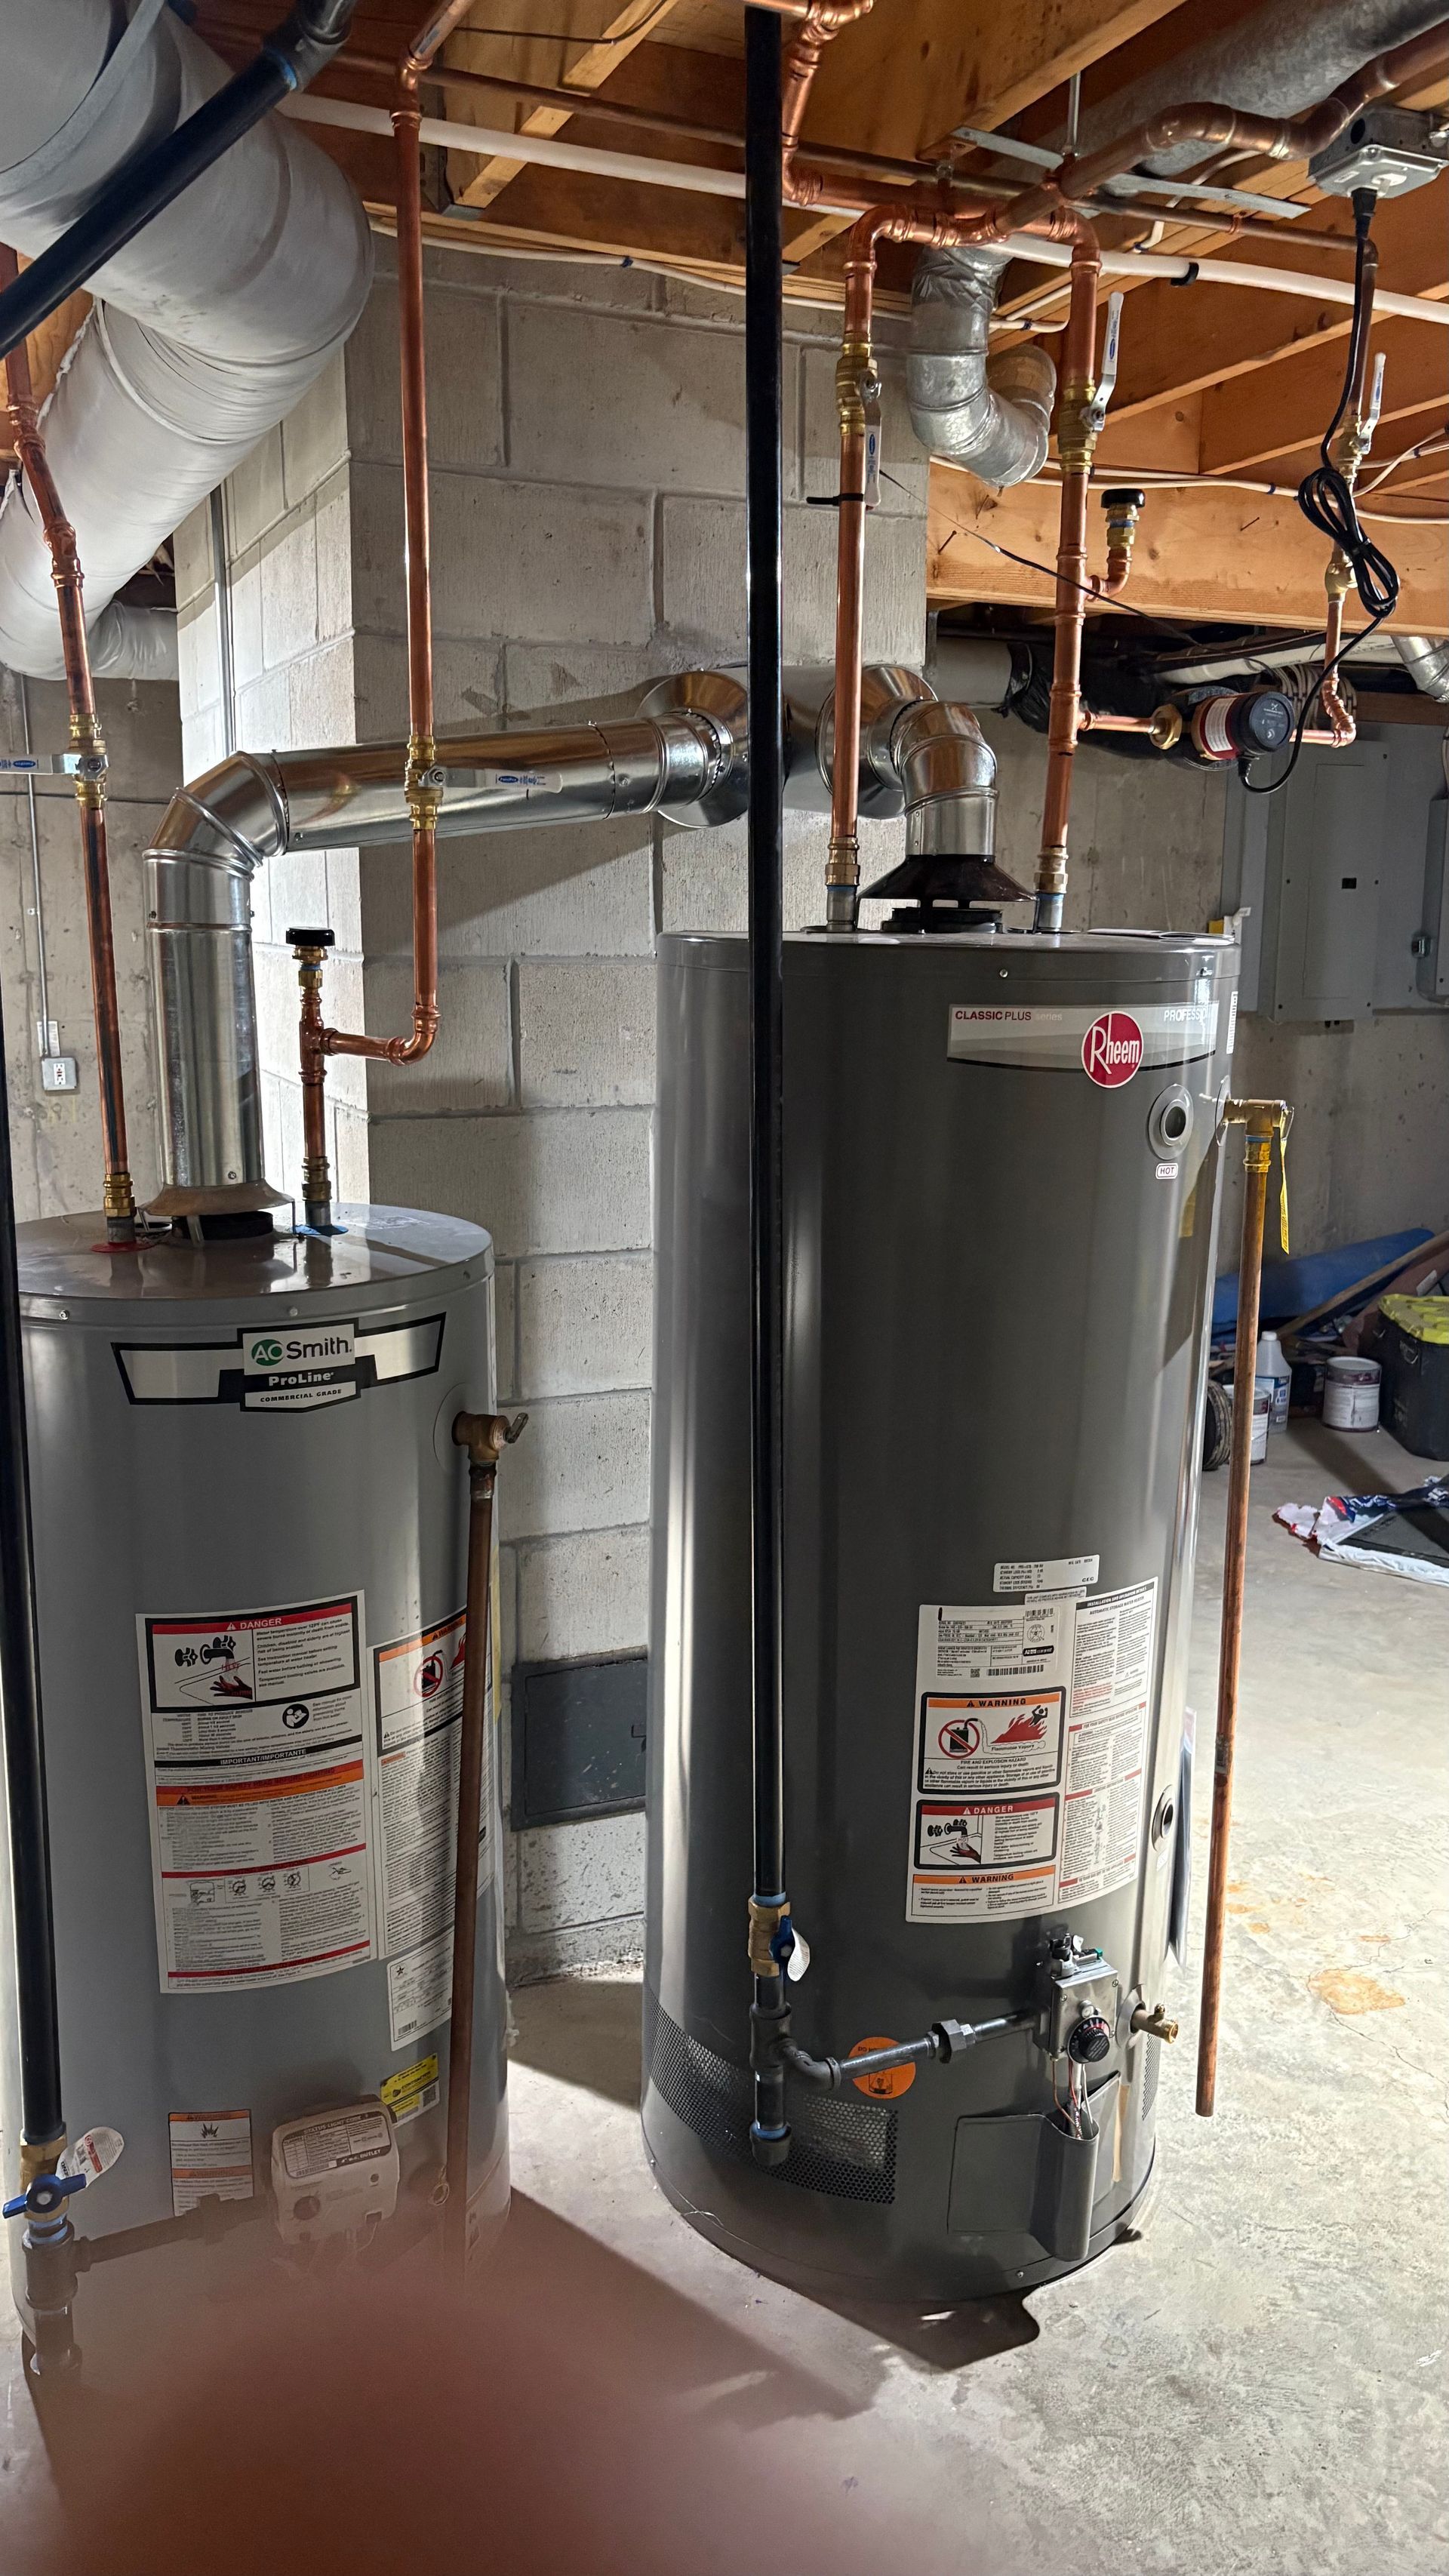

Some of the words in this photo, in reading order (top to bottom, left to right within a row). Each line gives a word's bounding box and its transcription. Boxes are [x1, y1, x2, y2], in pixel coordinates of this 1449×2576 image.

[955, 1011, 1002, 1020] CLASSIC
[1004, 1011, 1031, 1020] PLUS
[1090, 1014, 1140, 1075] Rheem
[260, 1393, 313, 1402] COMMERCIAL
[316, 1389, 342, 1397] GRADE
[240, 1618, 281, 1630] DANGER
[979, 1698, 1026, 1707] WARNING
[974, 1805, 1014, 1814] DANGER
[972, 1874, 1014, 1883] WARNING
[359, 2150, 381, 2159] OUTLET
